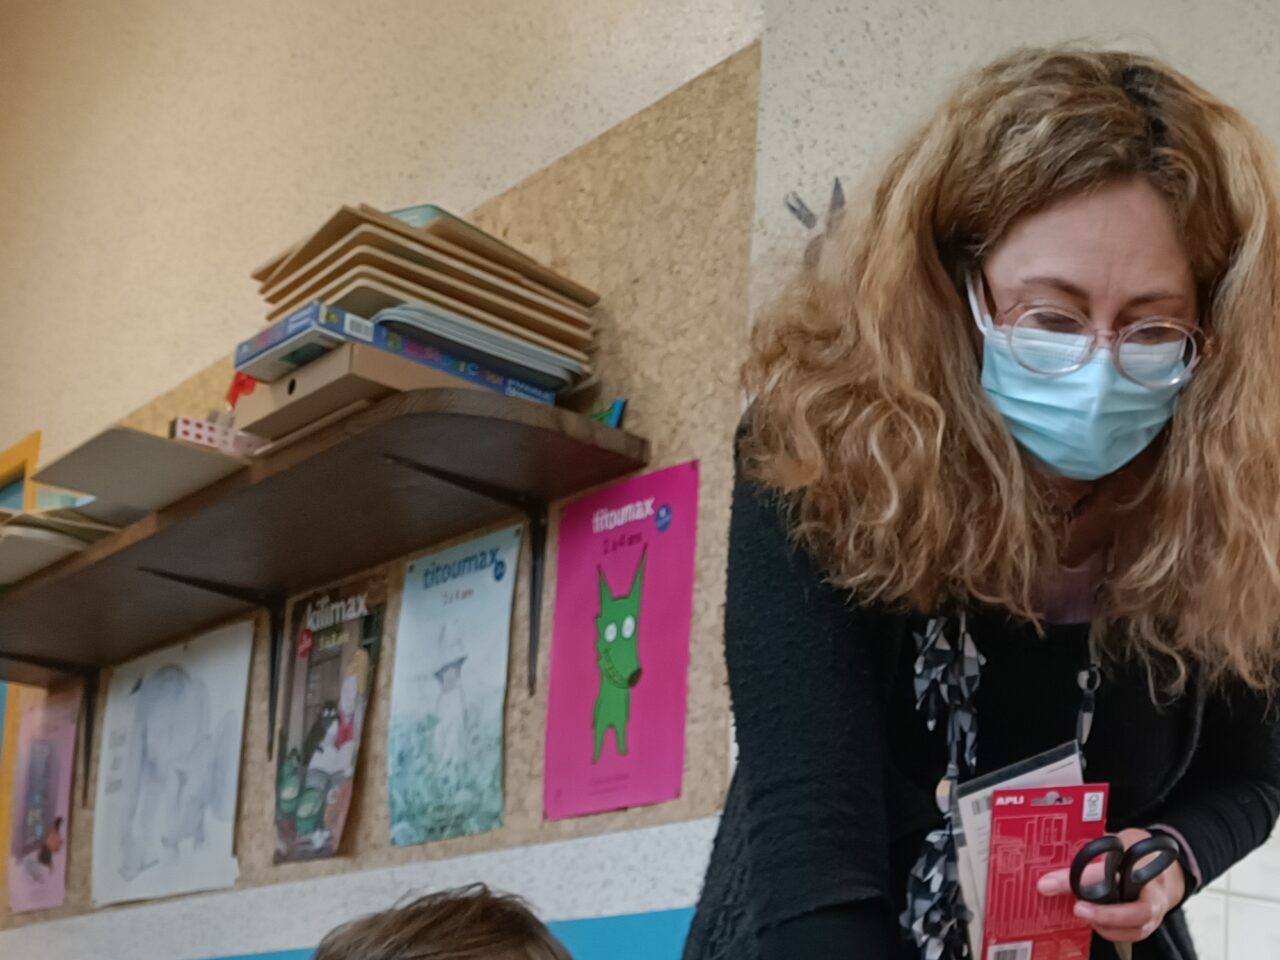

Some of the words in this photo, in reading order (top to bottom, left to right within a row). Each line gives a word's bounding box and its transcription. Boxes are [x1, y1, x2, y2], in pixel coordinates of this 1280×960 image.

[592, 496, 655, 534] titoumax
[423, 547, 499, 590] titoumax
[995, 795, 1025, 807] APLI
